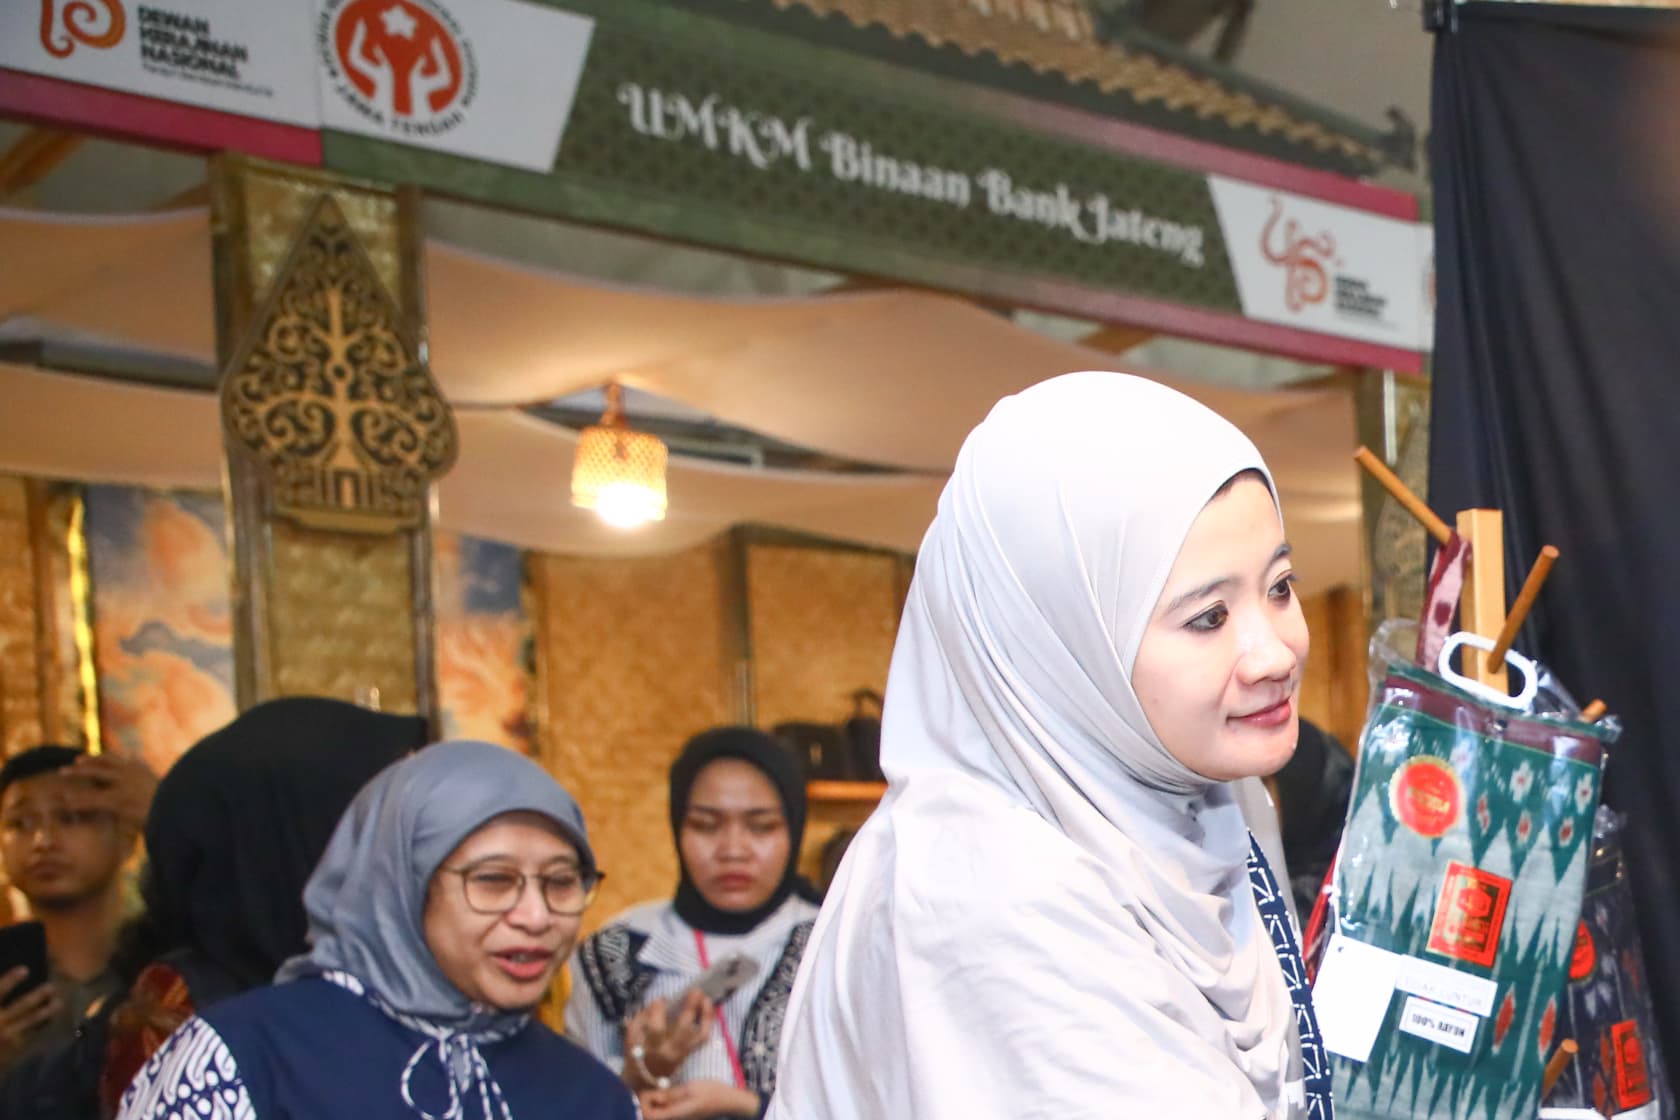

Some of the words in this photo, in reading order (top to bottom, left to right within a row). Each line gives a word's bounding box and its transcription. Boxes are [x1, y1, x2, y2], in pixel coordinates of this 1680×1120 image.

[138, 4, 210, 34] DEWAN
[140, 44, 240, 80] NASIONAL
[616, 81, 814, 172] UMKM
[819, 131, 972, 209] Binaan
[975, 167, 1082, 229] Bank
[1074, 192, 1206, 268] Jateng
